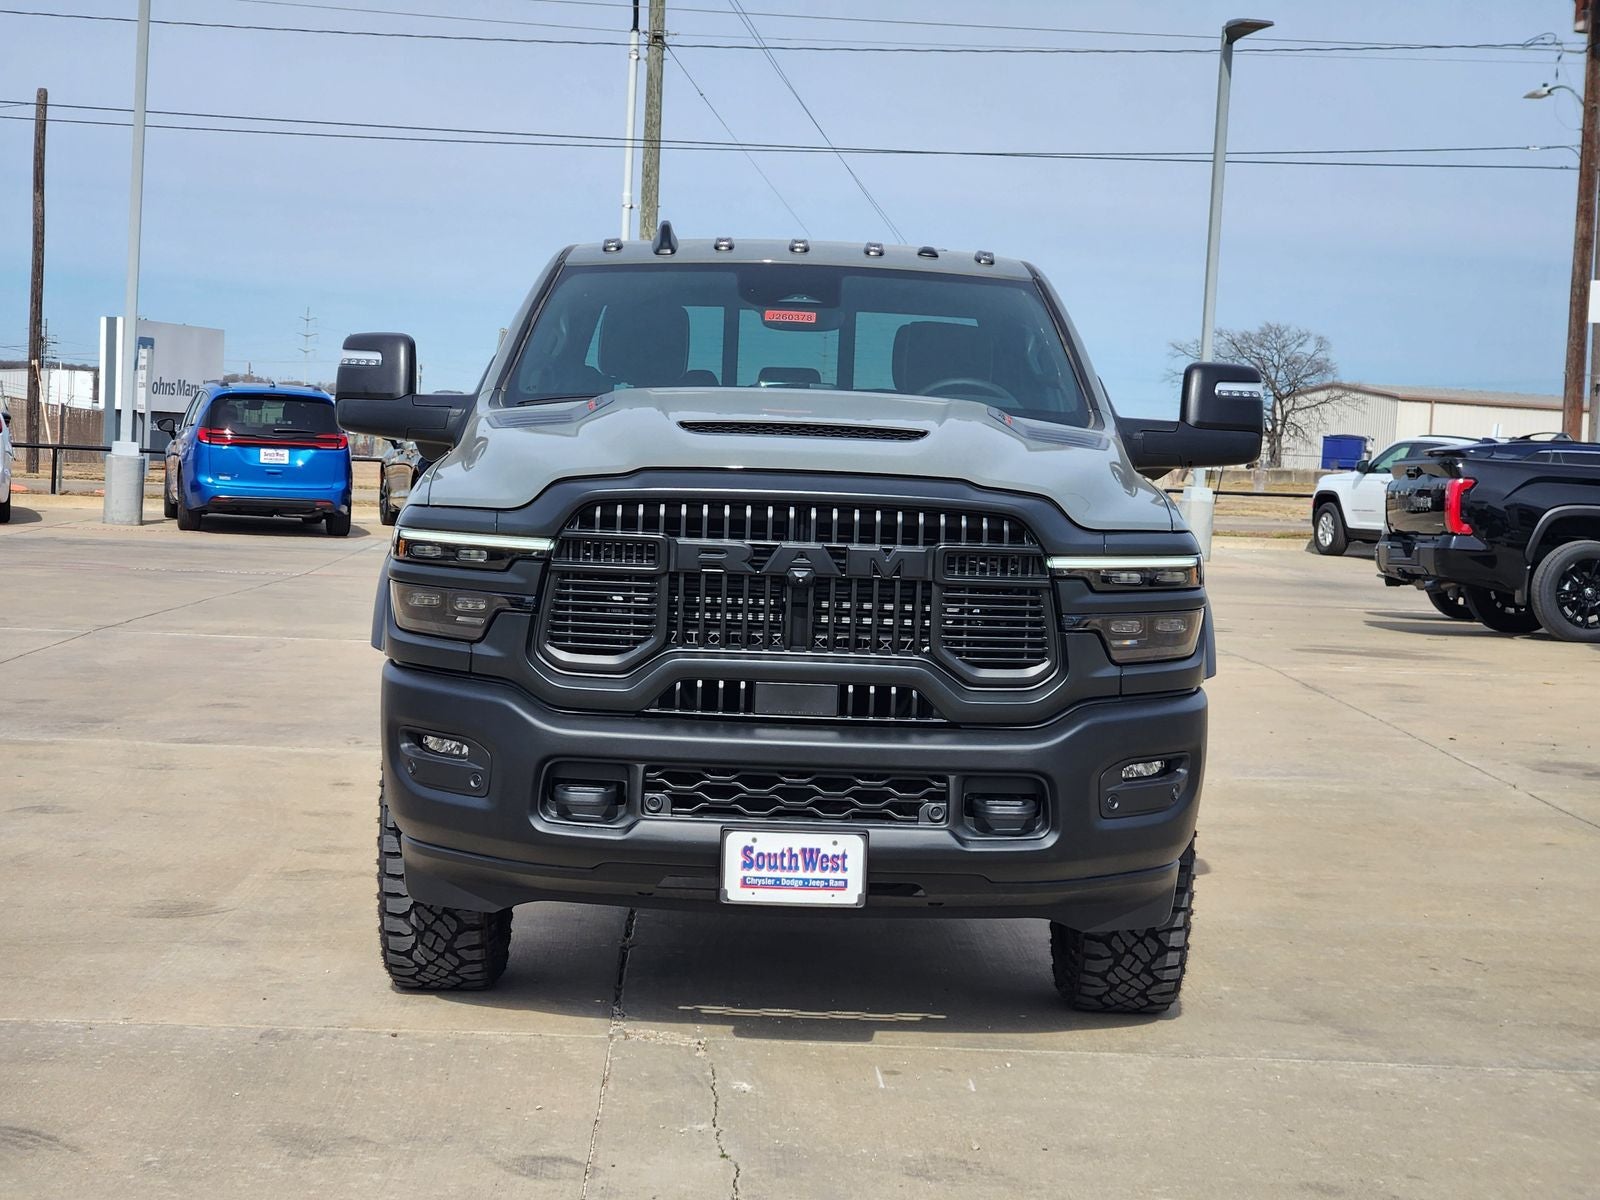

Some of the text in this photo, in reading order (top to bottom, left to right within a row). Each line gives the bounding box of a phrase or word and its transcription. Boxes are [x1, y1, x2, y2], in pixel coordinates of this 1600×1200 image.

[768, 313, 813, 321] J260378
[152, 376, 176, 396] ohns
[676, 539, 931, 579] RAM
[746, 877, 775, 886] Chrysler
[781, 878, 803, 887] Dodge
[808, 879, 825, 887] Jeep
